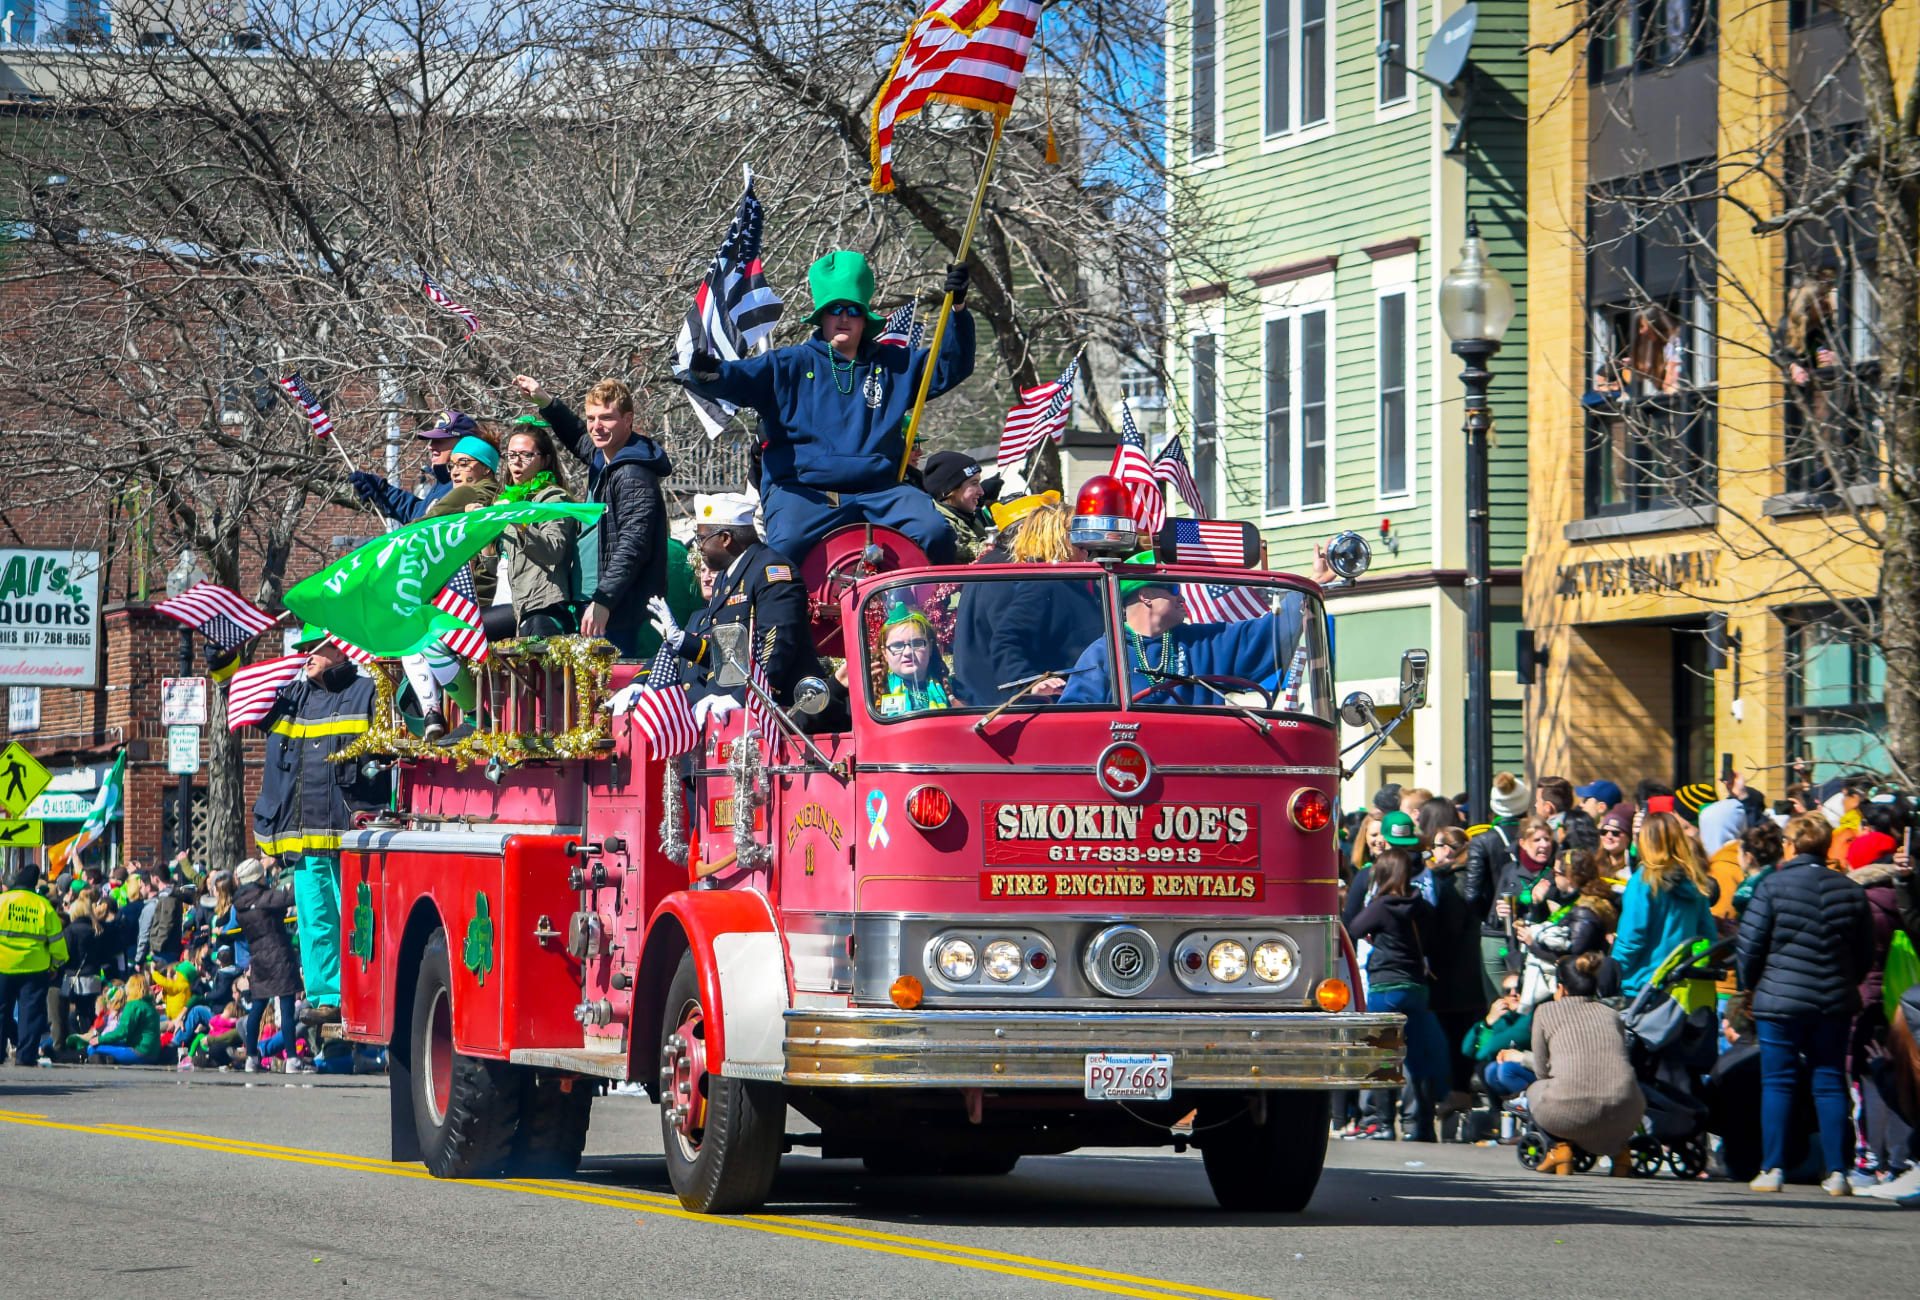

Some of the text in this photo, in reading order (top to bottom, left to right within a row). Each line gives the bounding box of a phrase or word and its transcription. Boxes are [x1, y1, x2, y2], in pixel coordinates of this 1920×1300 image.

[787, 802, 844, 851] ENGINE
[998, 804, 1248, 843] SMOKIN' JOE'S
[1049, 845, 1202, 863] 617-833-9913
[990, 874, 1256, 898] FIRE ENGINE RENTALS
[1105, 1056, 1153, 1065] Massachusetts
[1107, 1088, 1149, 1096] COMMERCIAL
